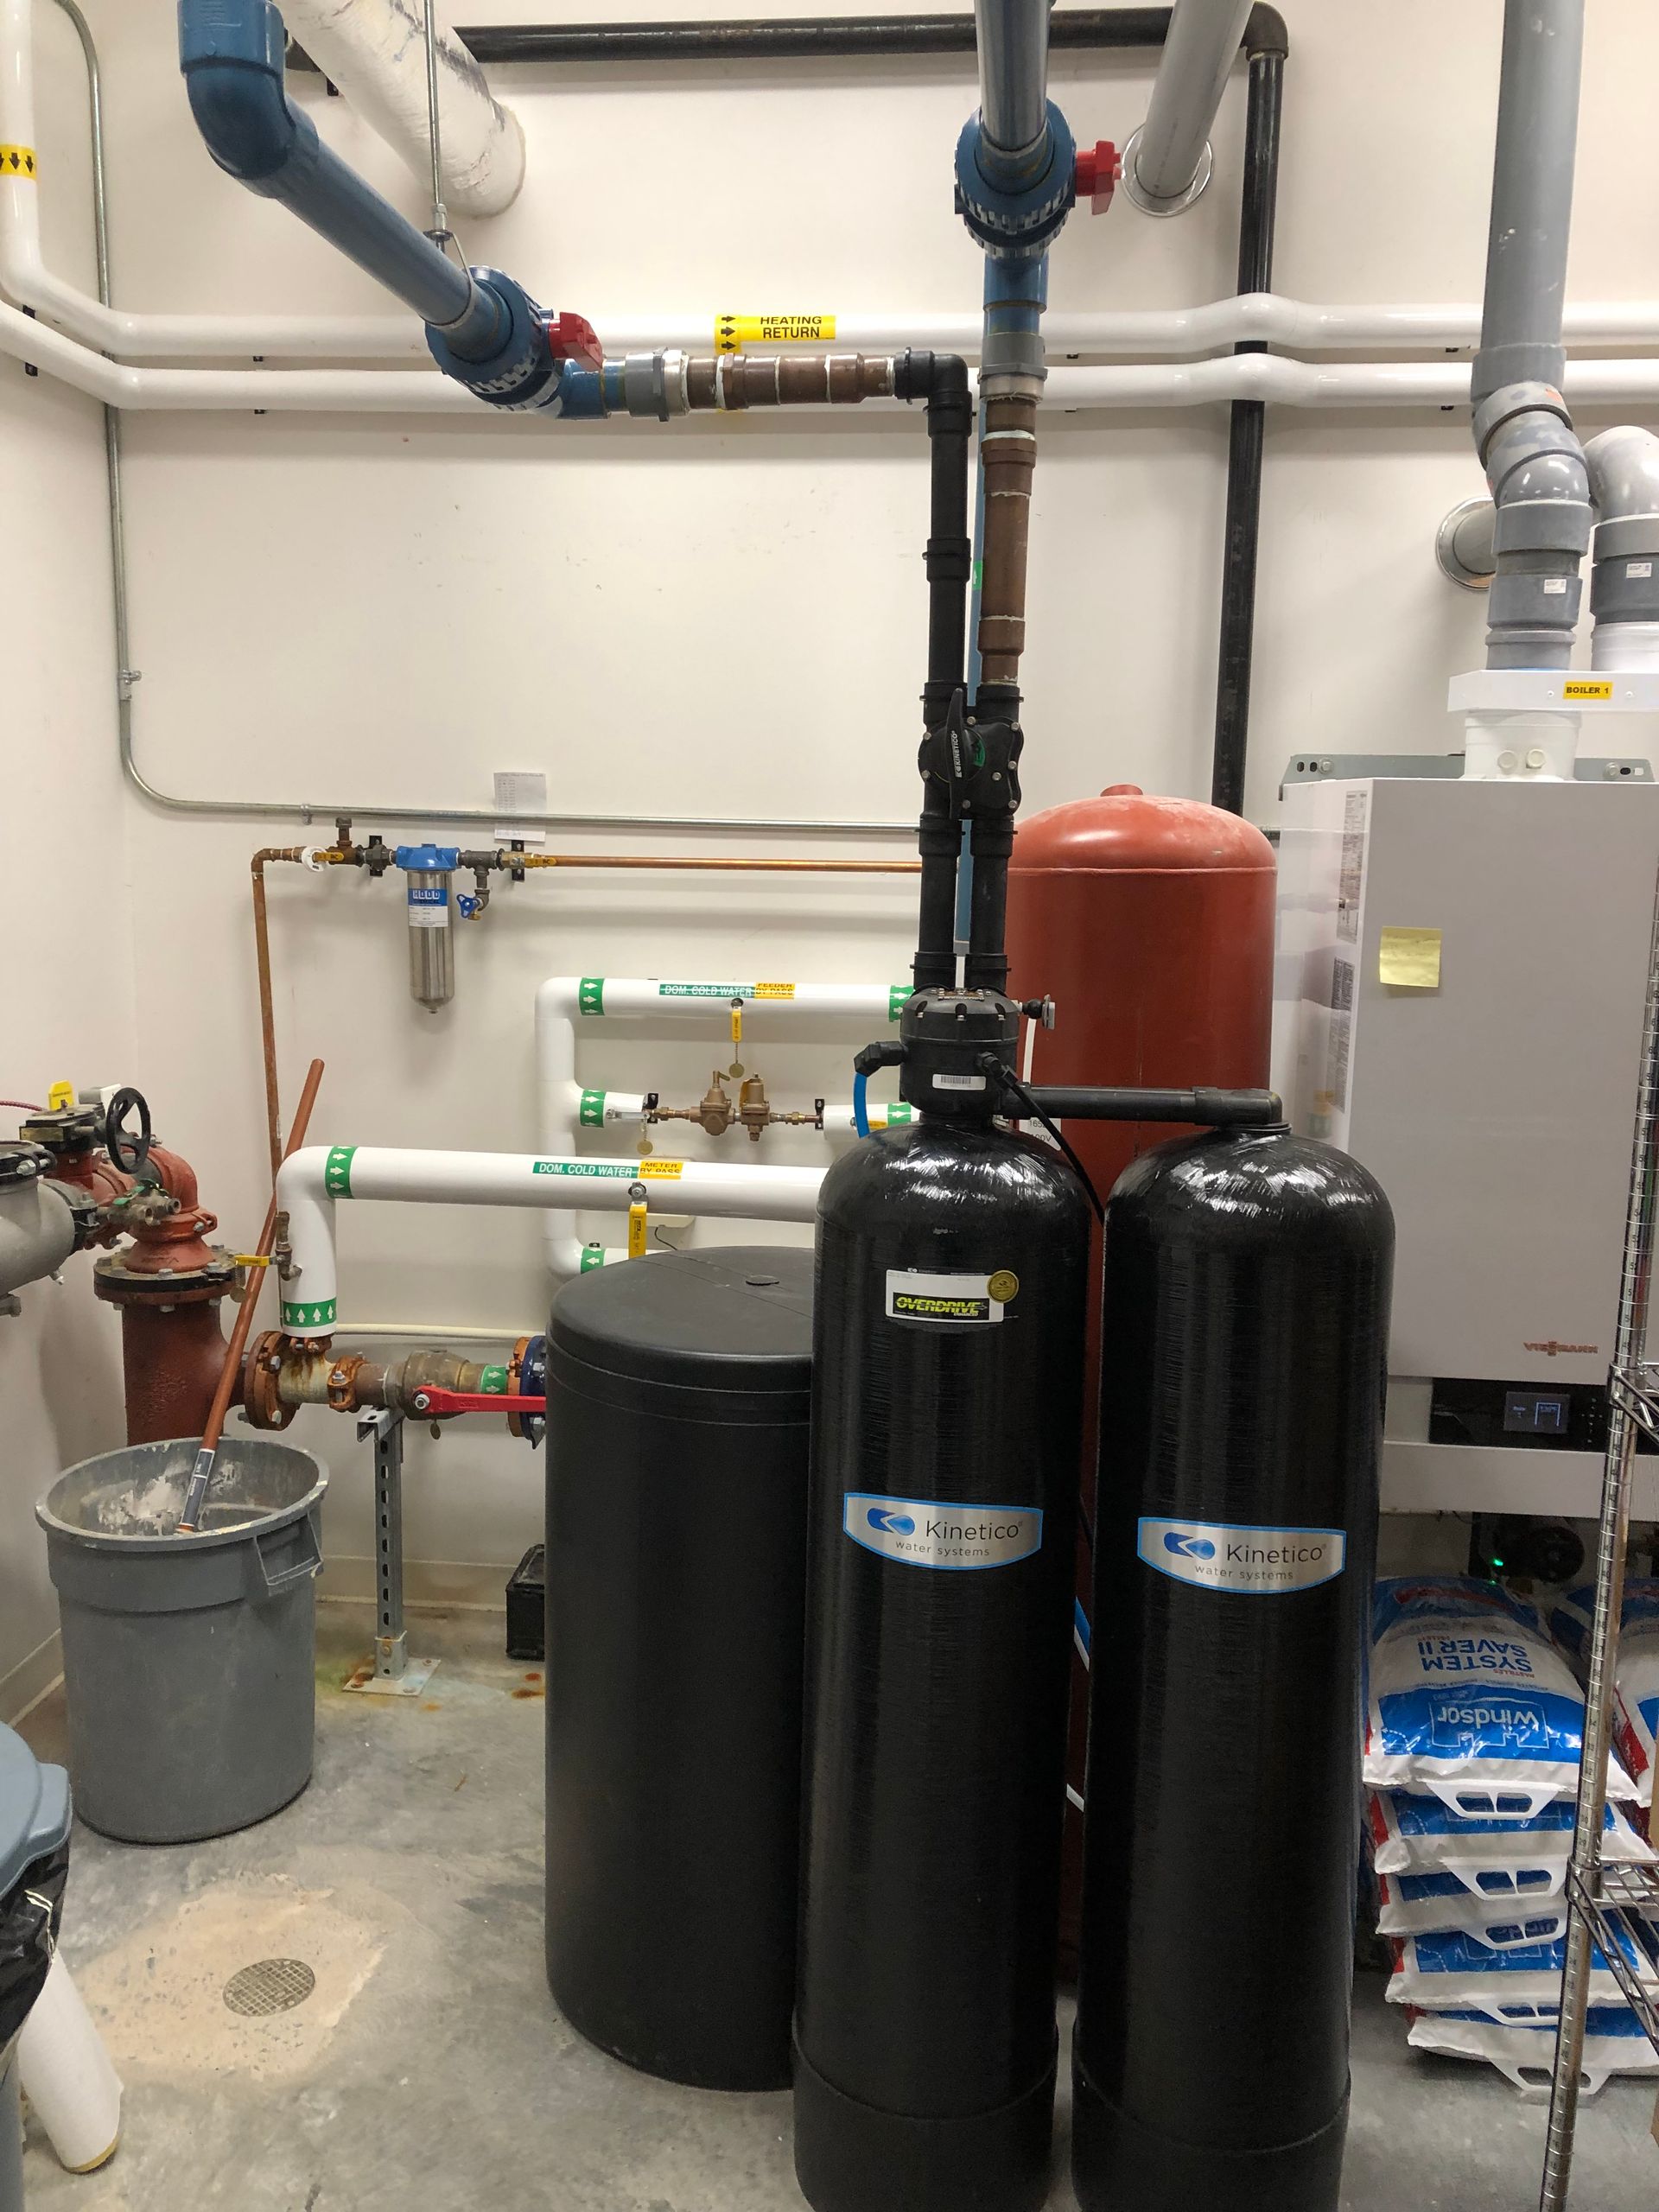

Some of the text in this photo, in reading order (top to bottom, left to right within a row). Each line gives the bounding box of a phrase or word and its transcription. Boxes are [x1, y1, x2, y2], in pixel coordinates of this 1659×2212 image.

[760, 316, 822, 325] HEATING
[763, 327, 820, 339] RETURN
[664, 985, 752, 997] DOM. COLD WATER
[539, 1163, 632, 1178] DOM. COLD WATER
[896, 1296, 982, 1314] OVERDRIVE
[926, 1520, 1019, 1541] Kinetico
[895, 1541, 989, 1556] water systems
[1226, 1543, 1323, 1564] Kinetico
[1194, 1565, 1294, 1580] water systems
[1440, 1638, 1528, 1657] SAVER
[1422, 1655, 1533, 1673] SYSTEM
[1437, 1706, 1540, 1730] windsor
